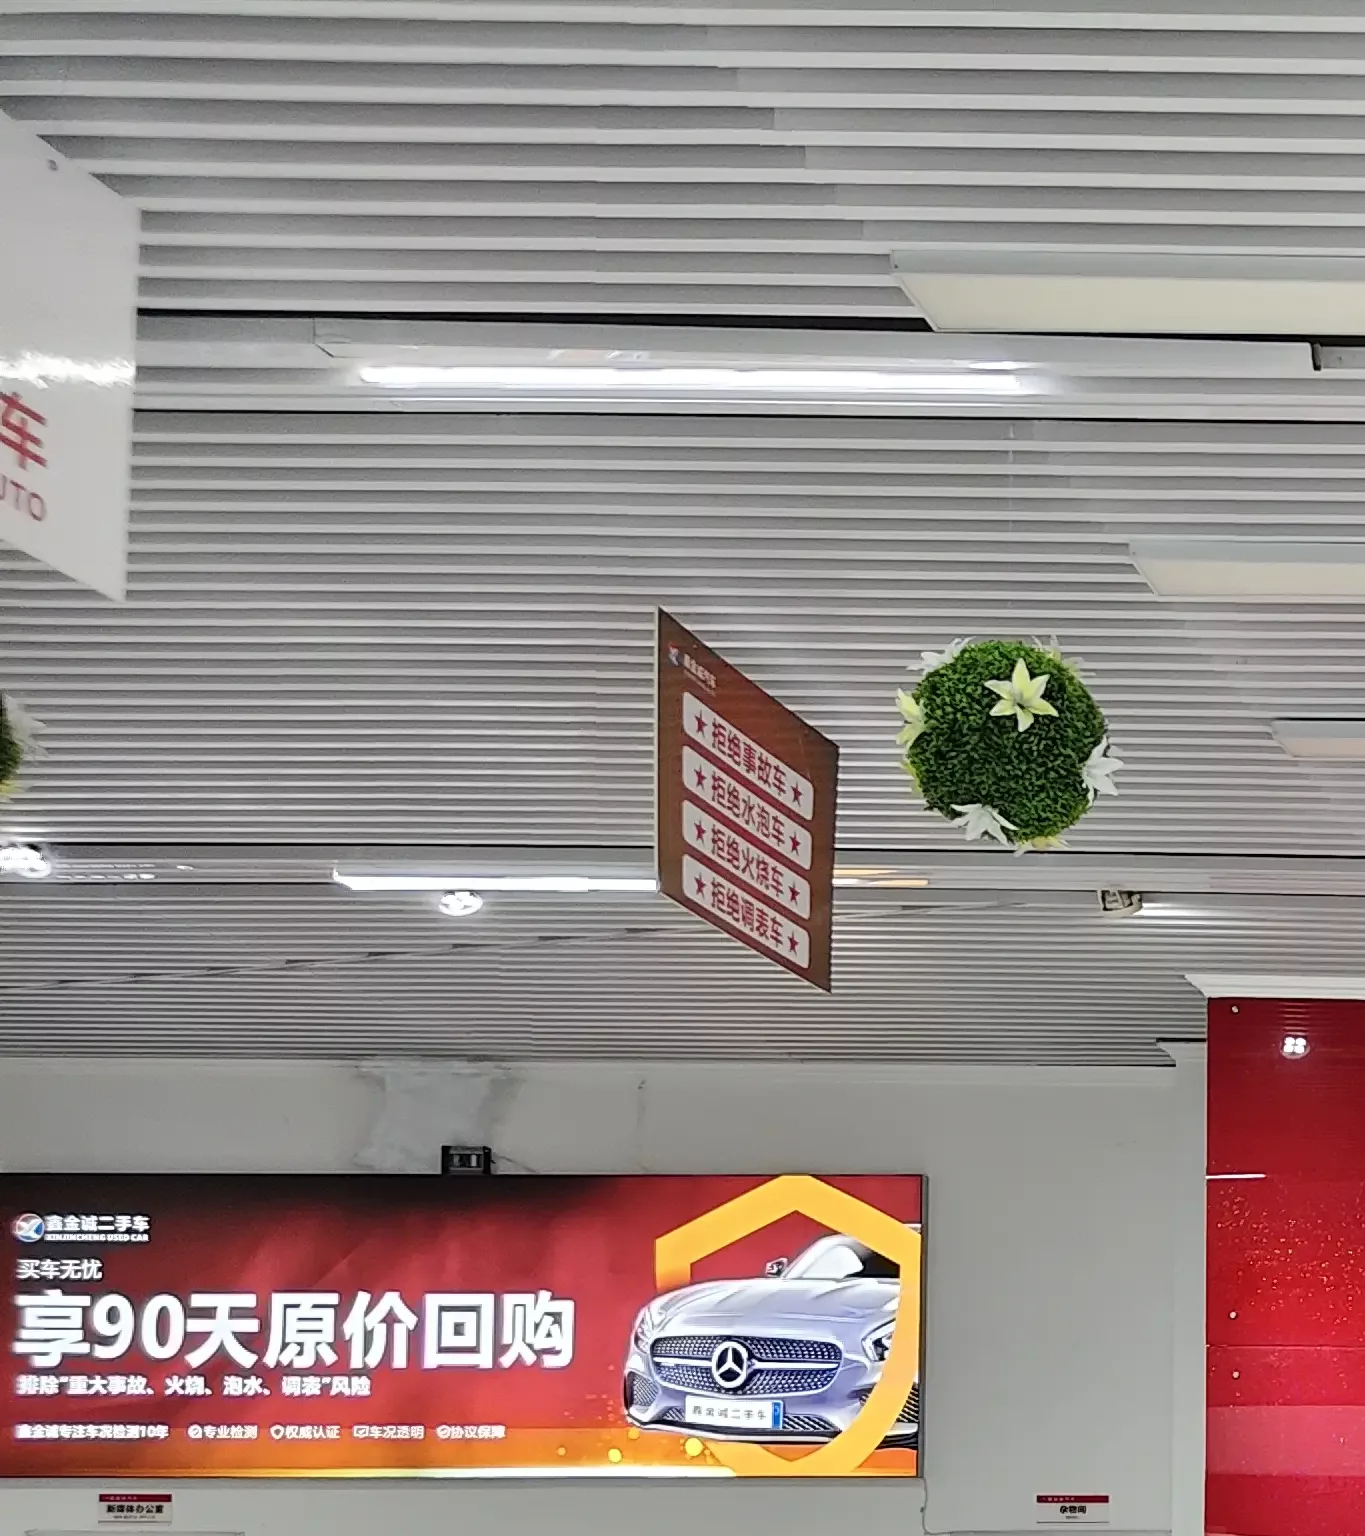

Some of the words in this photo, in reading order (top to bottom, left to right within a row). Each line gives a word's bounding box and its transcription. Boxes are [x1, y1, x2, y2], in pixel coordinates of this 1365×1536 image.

[711, 717, 787, 797] 拒绝事故车
[711, 770, 786, 848] 拒绝水泡车
[711, 823, 785, 898] 拒绝火烧车
[711, 876, 784, 950] 拒绝调表车
[45, 1214, 150, 1232] 鑫金诚二手车
[131, 1233, 149, 1242] CAR
[16, 1258, 103, 1280] 买车无忧
[13, 1288, 576, 1369] 享90天原价回购
[203, 1424, 258, 1439] 专业检测
[285, 1425, 341, 1439] 权威认证
[369, 1425, 424, 1439] 车况透明
[450, 1425, 506, 1439] 协议保障
